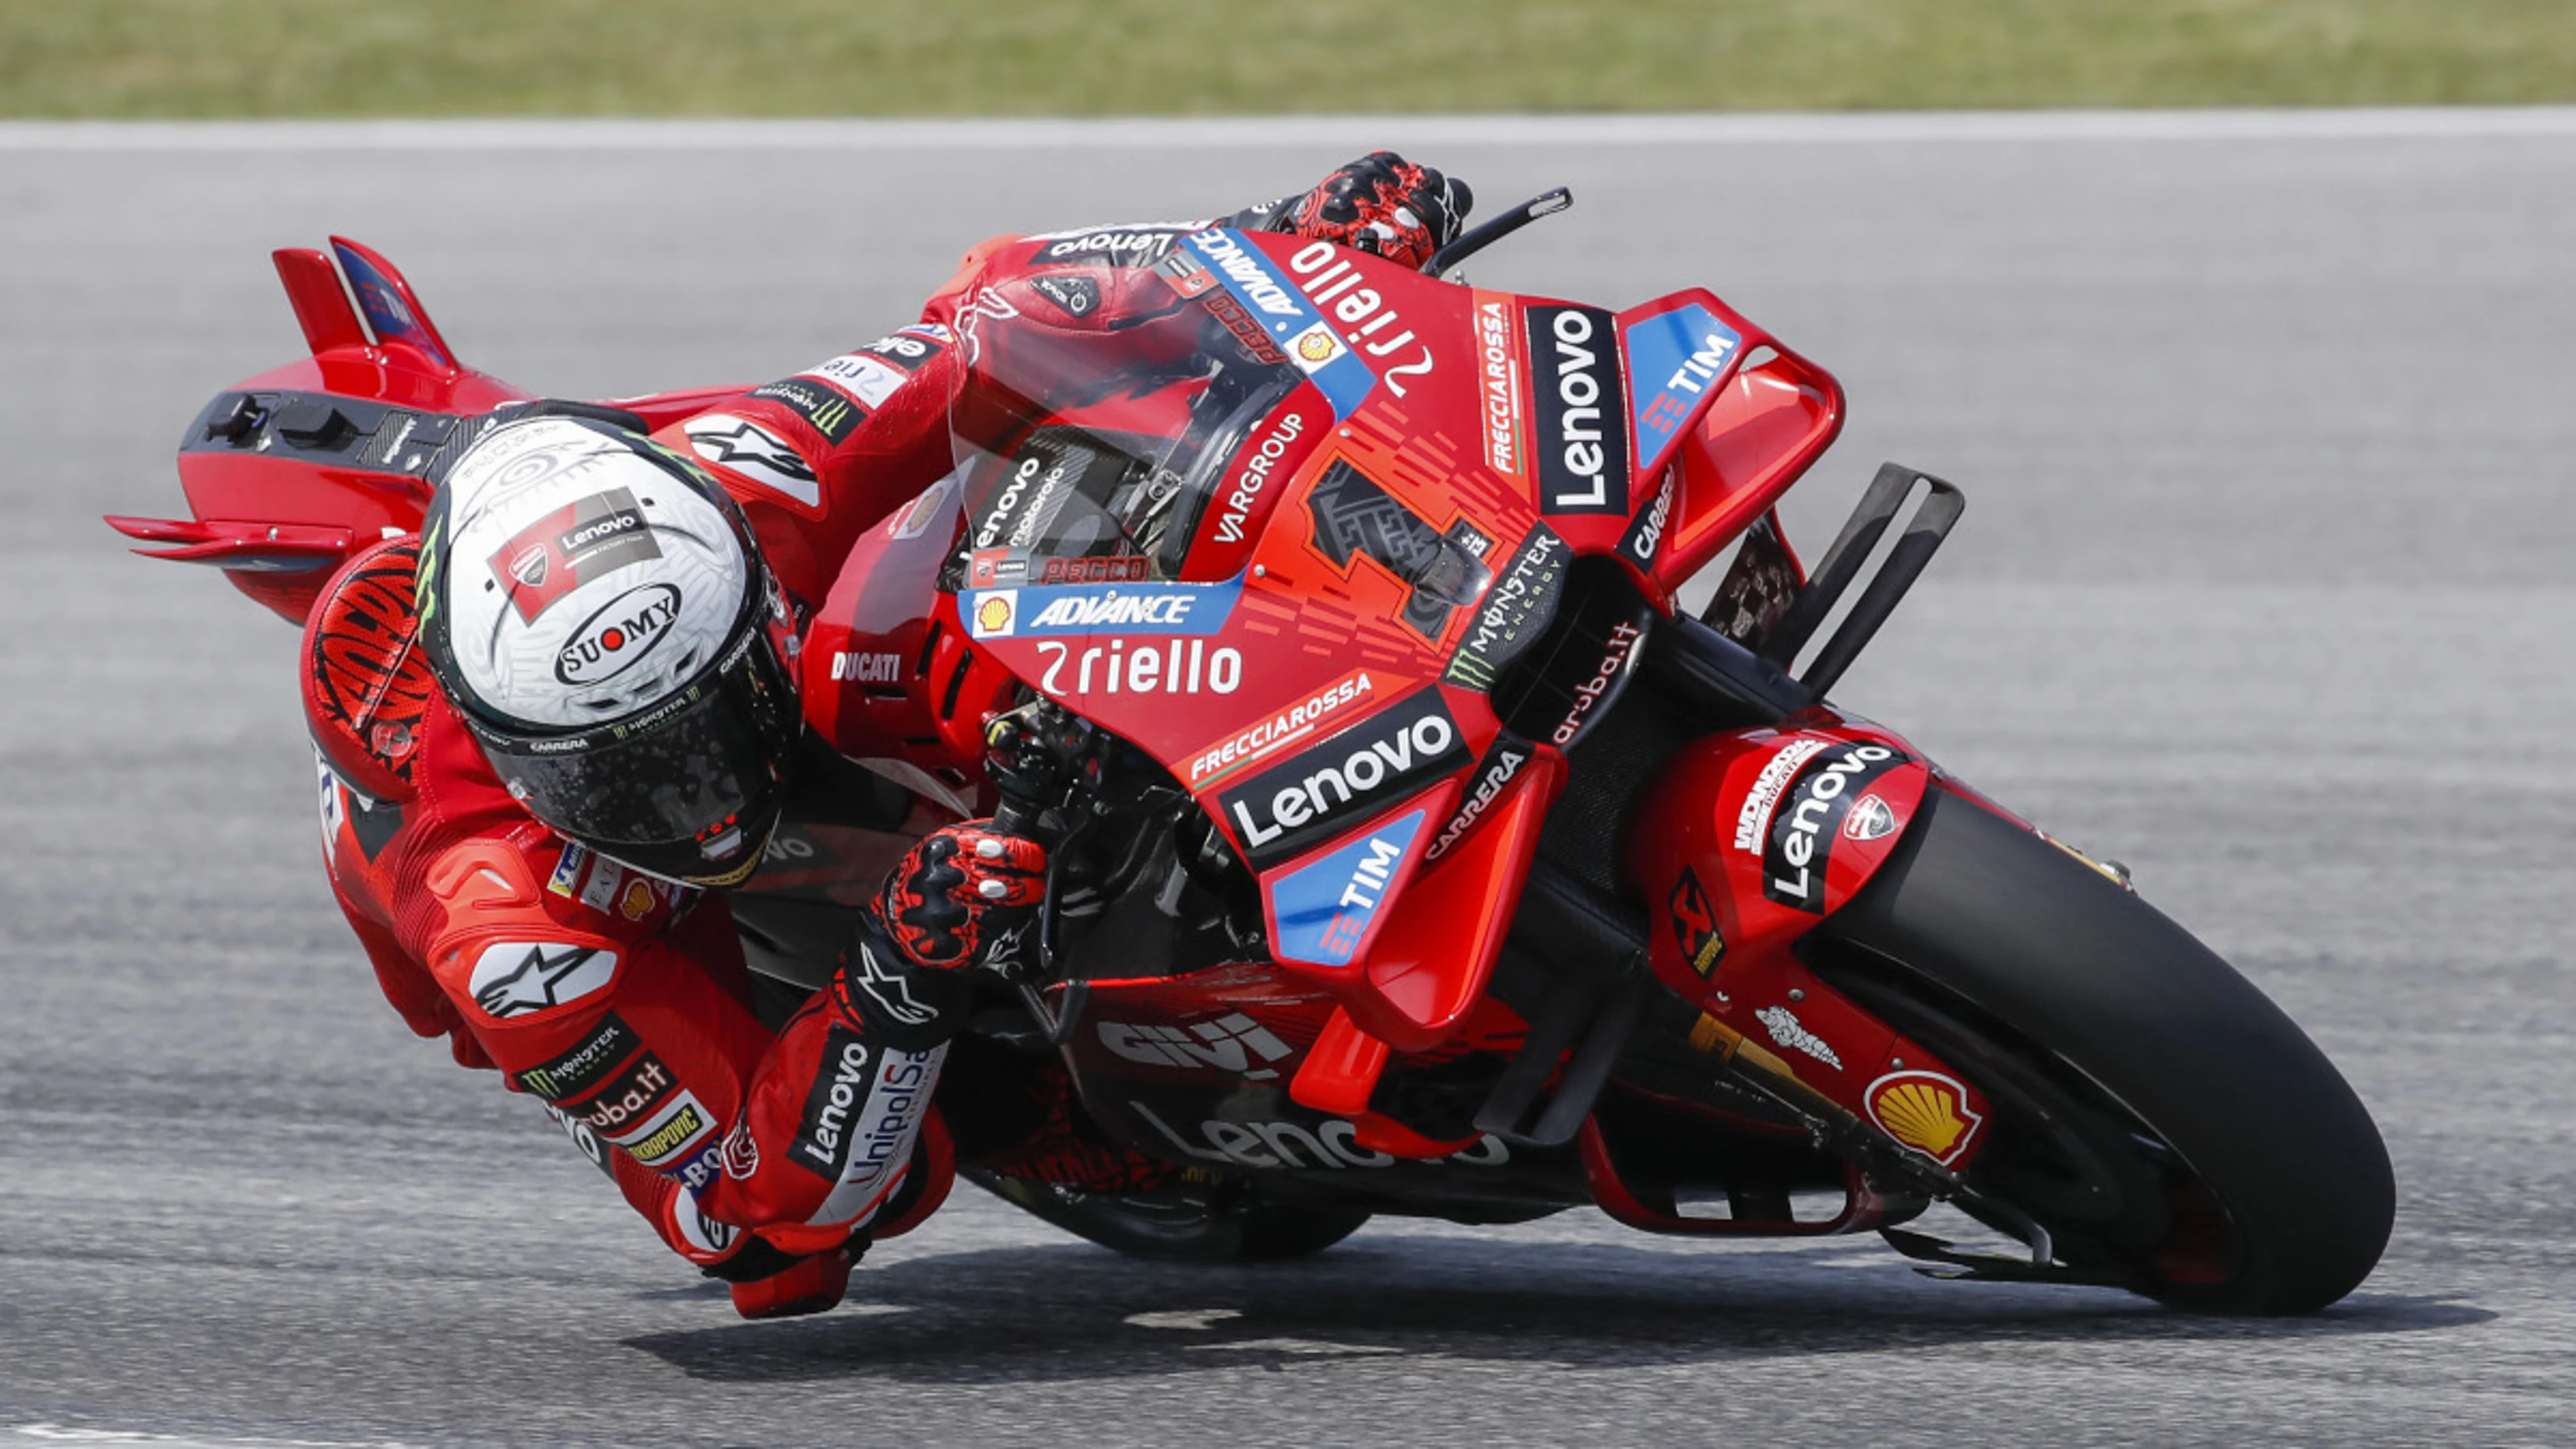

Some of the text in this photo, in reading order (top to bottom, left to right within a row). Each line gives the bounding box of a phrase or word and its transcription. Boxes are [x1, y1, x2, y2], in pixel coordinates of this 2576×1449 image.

[1051, 233, 1174, 257] Lenovo
[1190, 229, 1303, 316] ADVANCE
[1482, 302, 1514, 474] FRECCIAROSSA
[1667, 333, 1735, 394] TIM
[1553, 309, 1607, 507] Lenovo
[1214, 413, 1303, 544] VARGROUP
[562, 515, 635, 550] Lenovo
[1039, 555, 1149, 585] PECCO
[564, 597, 675, 673] SUOMY
[1030, 593, 1195, 628] ADVANCE
[1470, 534, 1560, 653] MONSTER
[1505, 560, 1561, 641] ENERGY
[830, 651, 901, 682] DUCATI
[1552, 621, 1640, 745] aruba.it
[530, 738, 589, 753] CARRERA
[1191, 672, 1373, 781] FRECCIAROSSA
[1232, 714, 1452, 848] Lenovo
[1426, 750, 1524, 861] CARRERA
[1774, 746, 1892, 899] Lenovo
[1338, 837, 1401, 910] TIM
[1096, 1012, 1293, 1081] GIVI
[804, 1042, 868, 1165] Lenovo
